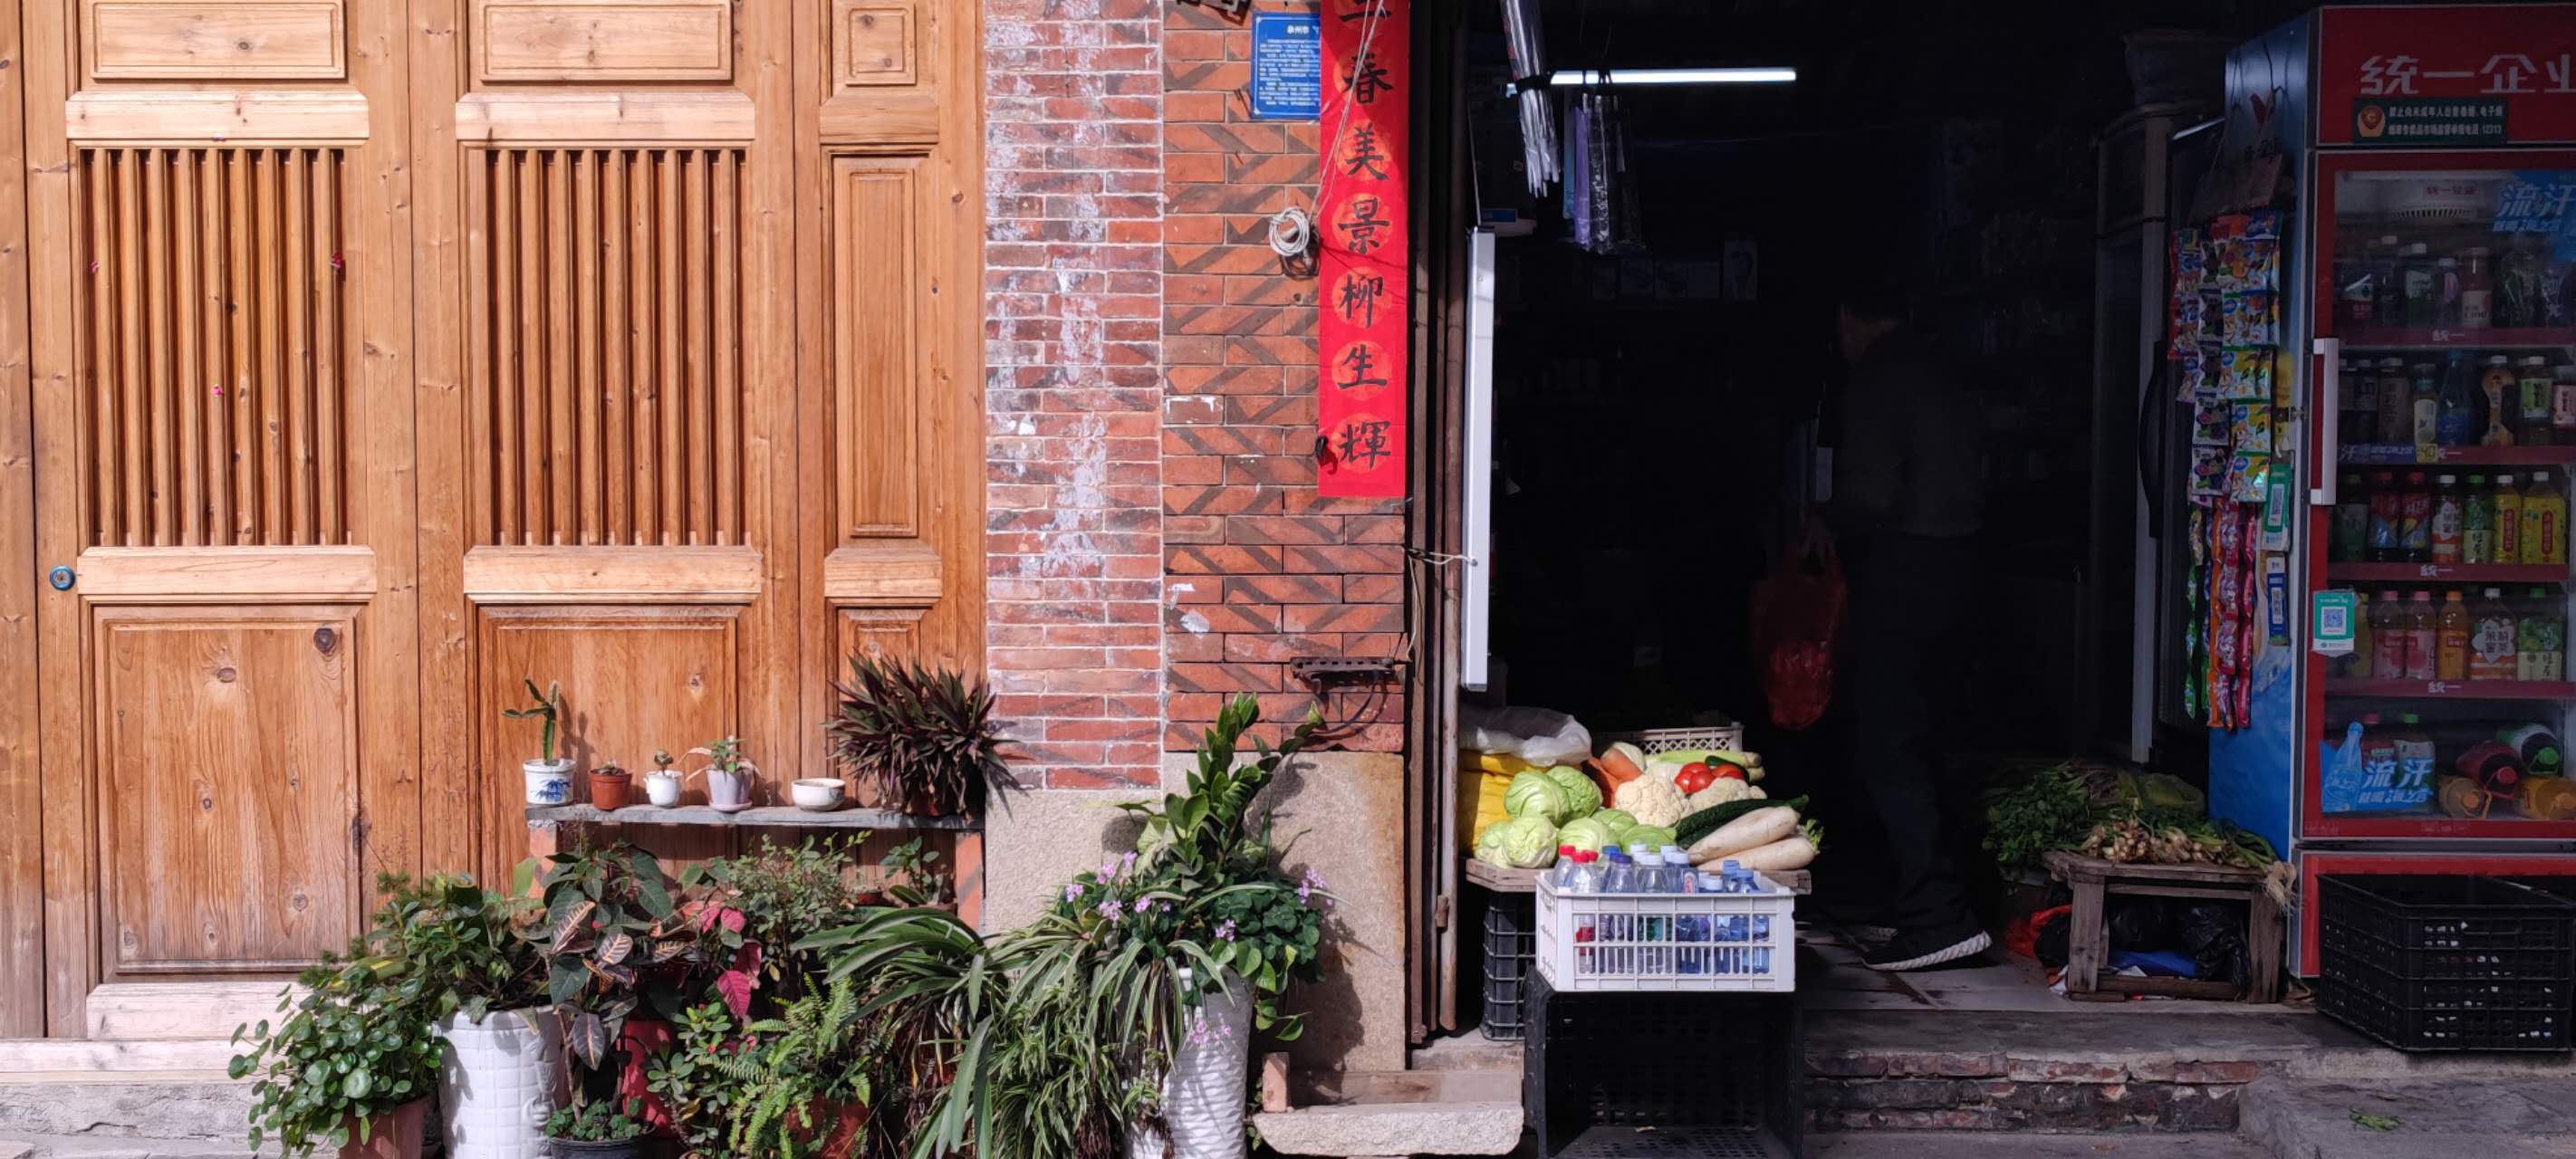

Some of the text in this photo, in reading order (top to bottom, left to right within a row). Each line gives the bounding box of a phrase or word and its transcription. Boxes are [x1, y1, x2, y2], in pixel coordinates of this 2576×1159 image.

[2360, 54, 2576, 94] 统一企业
[2361, 759, 2435, 789] 流汗
